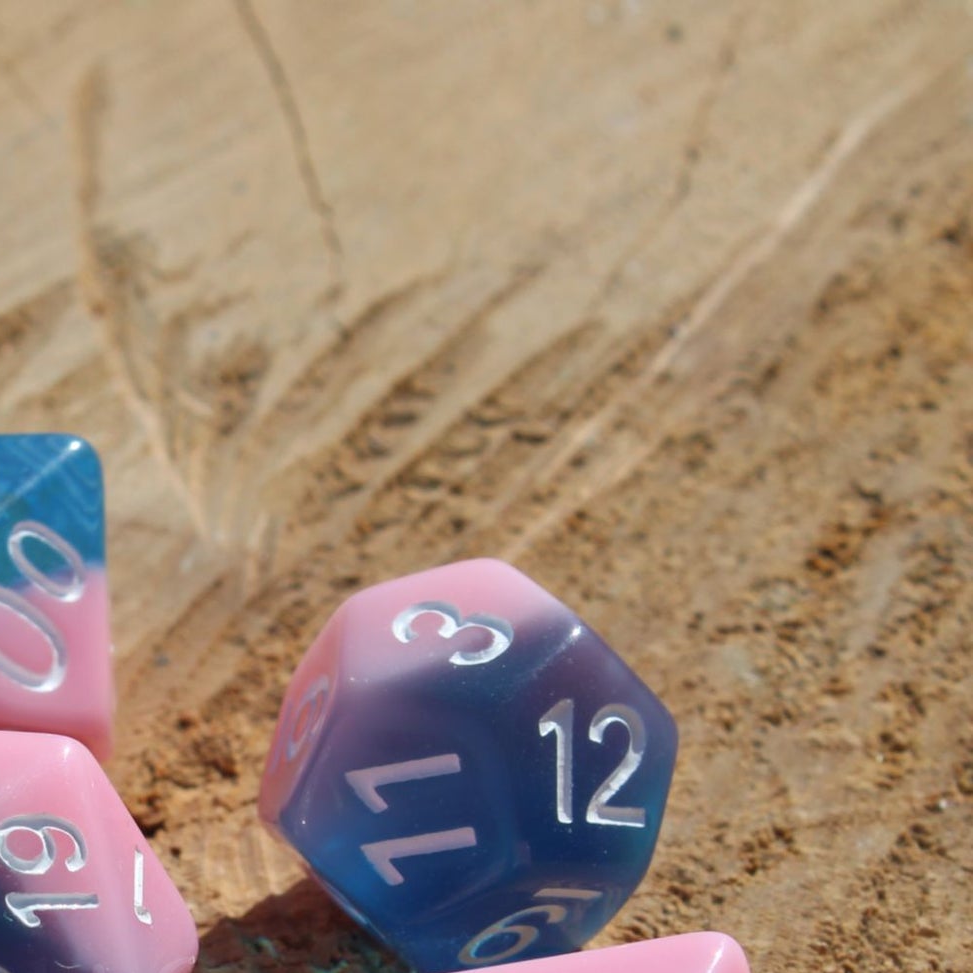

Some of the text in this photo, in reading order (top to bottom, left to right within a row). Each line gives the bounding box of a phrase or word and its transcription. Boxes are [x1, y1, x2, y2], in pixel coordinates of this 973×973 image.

[392, 601, 515, 666] 3
[345, 753, 477, 887] 11
[539, 699, 647, 828] 12
